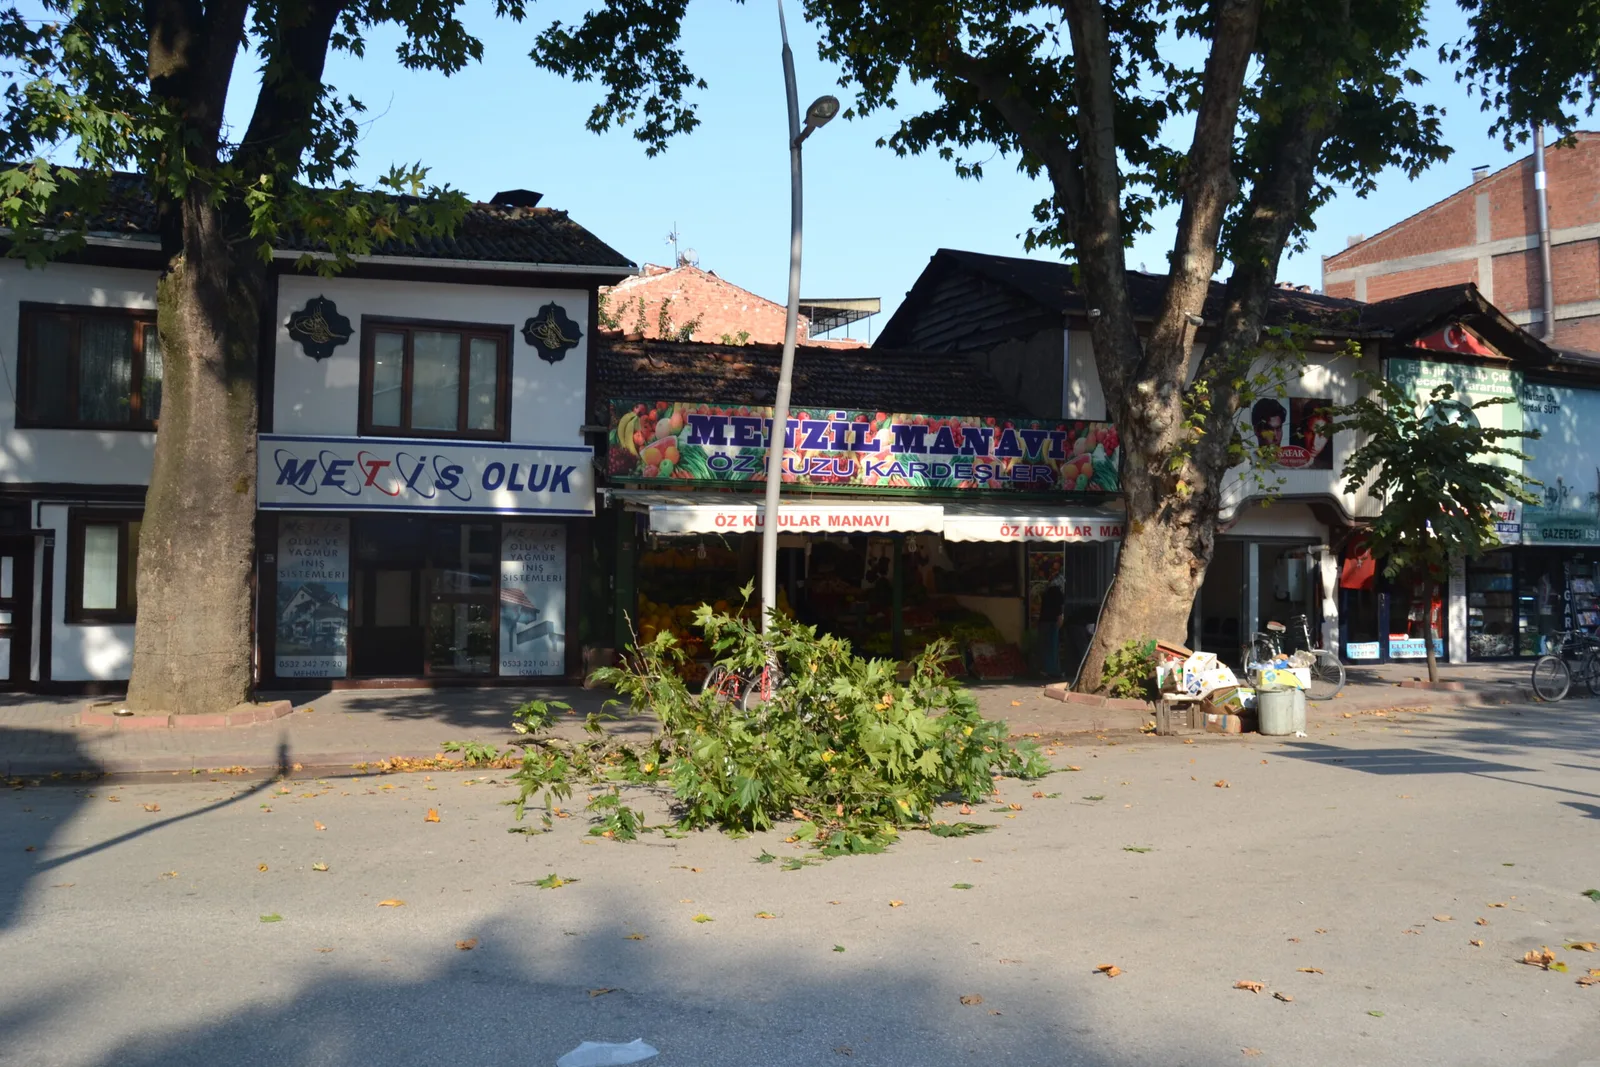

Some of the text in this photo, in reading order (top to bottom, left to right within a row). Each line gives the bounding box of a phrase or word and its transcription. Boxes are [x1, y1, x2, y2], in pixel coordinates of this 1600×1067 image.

[687, 411, 1067, 459] MENZİL MANAVI
[706, 451, 756, 473] ÖZ
[865, 460, 1053, 483] KARDEŞLER
[481, 461, 577, 493] OLUK
[715, 513, 890, 527] ÖZ KUULAR MANAVI
[1000, 523, 1020, 537] ÖZ
[1024, 525, 1092, 537] KUZULAR
[325, 537, 339, 546] VE
[510, 543, 557, 551] OLUK VE
[510, 552, 556, 562] YAĞMUR
